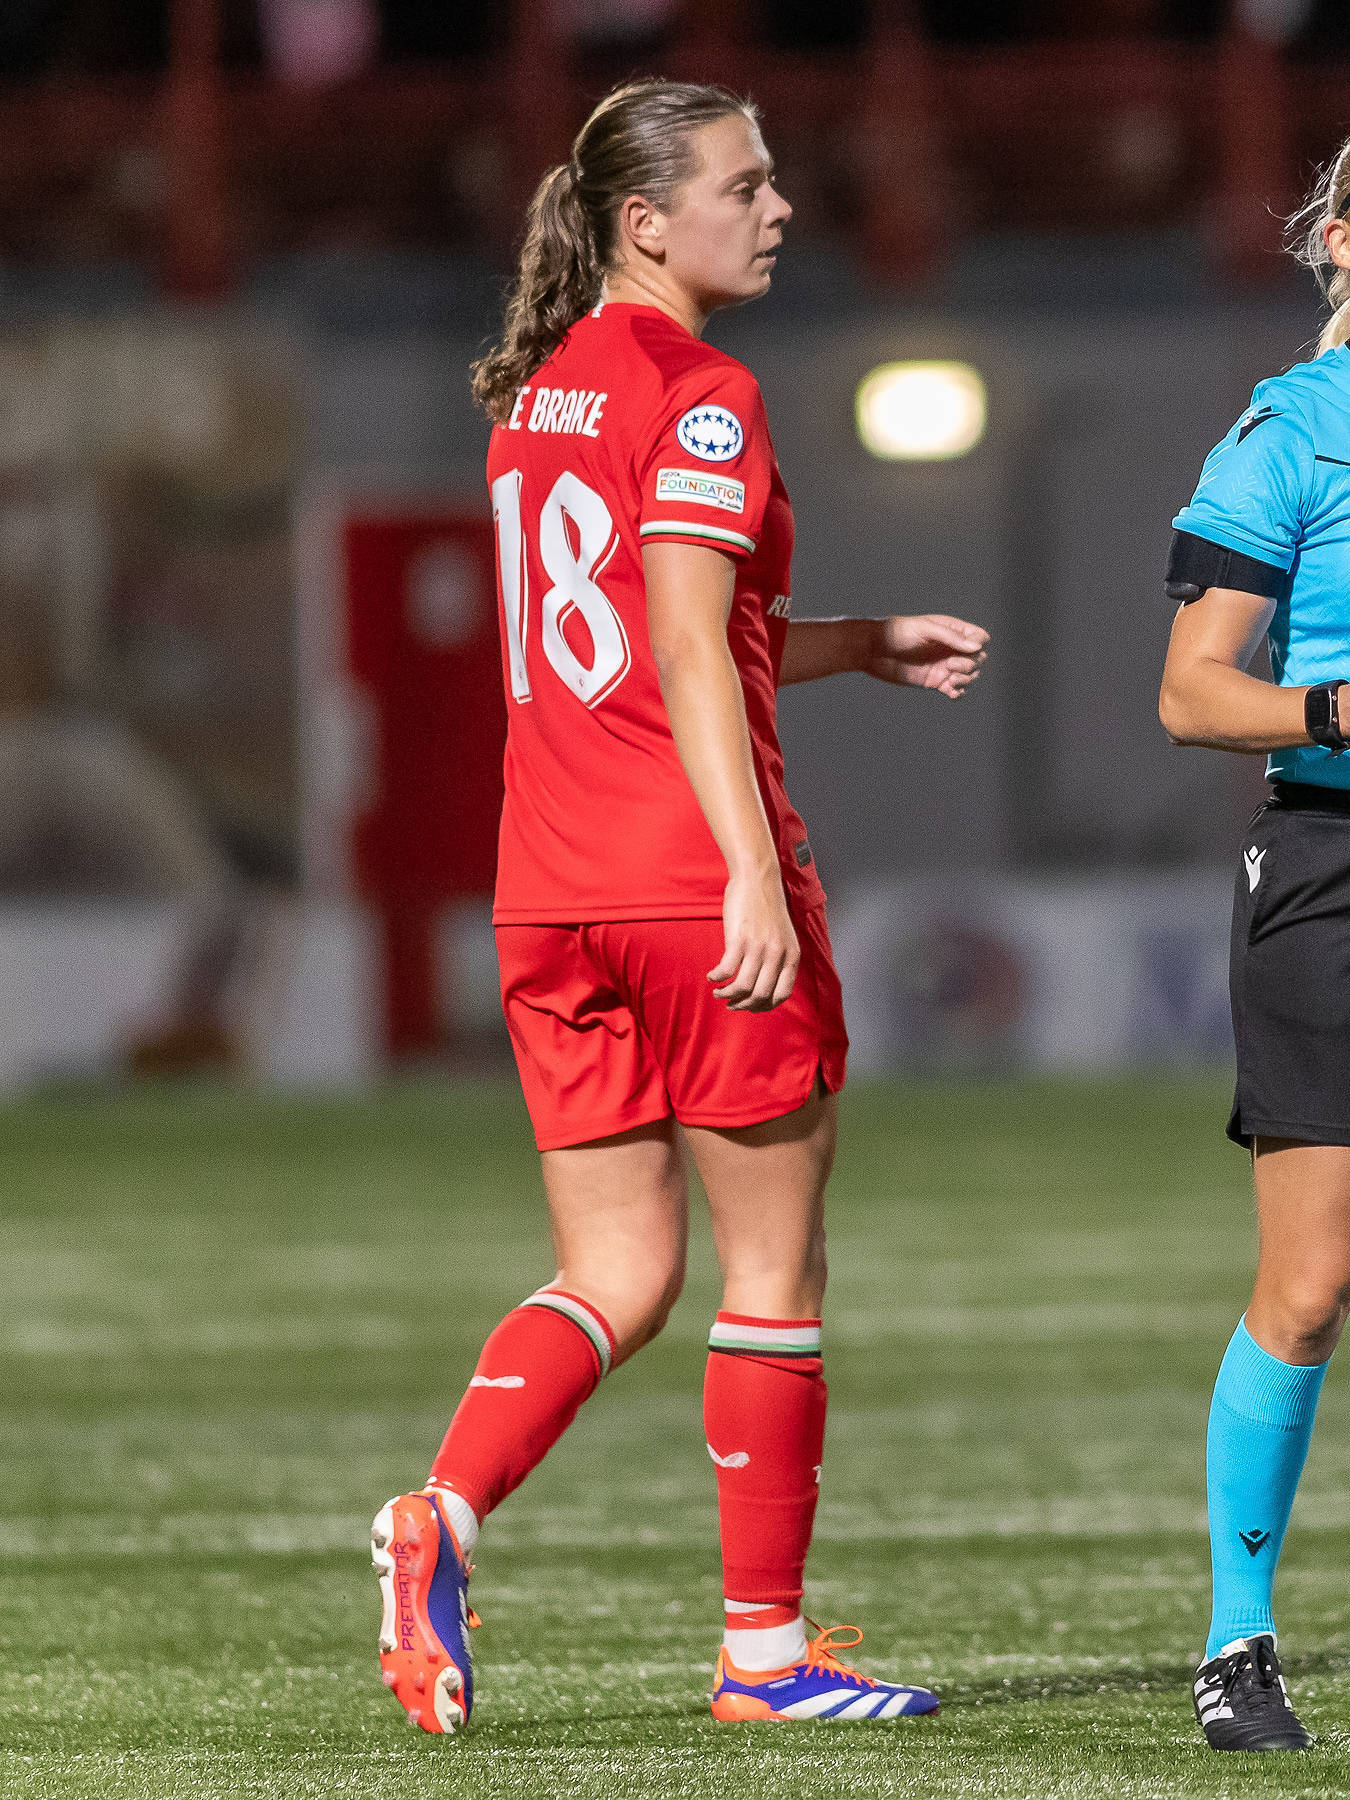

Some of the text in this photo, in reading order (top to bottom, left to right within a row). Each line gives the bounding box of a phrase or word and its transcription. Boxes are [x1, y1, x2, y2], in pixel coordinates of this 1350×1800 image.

[505, 385, 608, 438] E BRAKE
[659, 479, 743, 502] FOUNDATION
[491, 467, 632, 710] 18
[394, 1541, 415, 1651] PREDATOR
